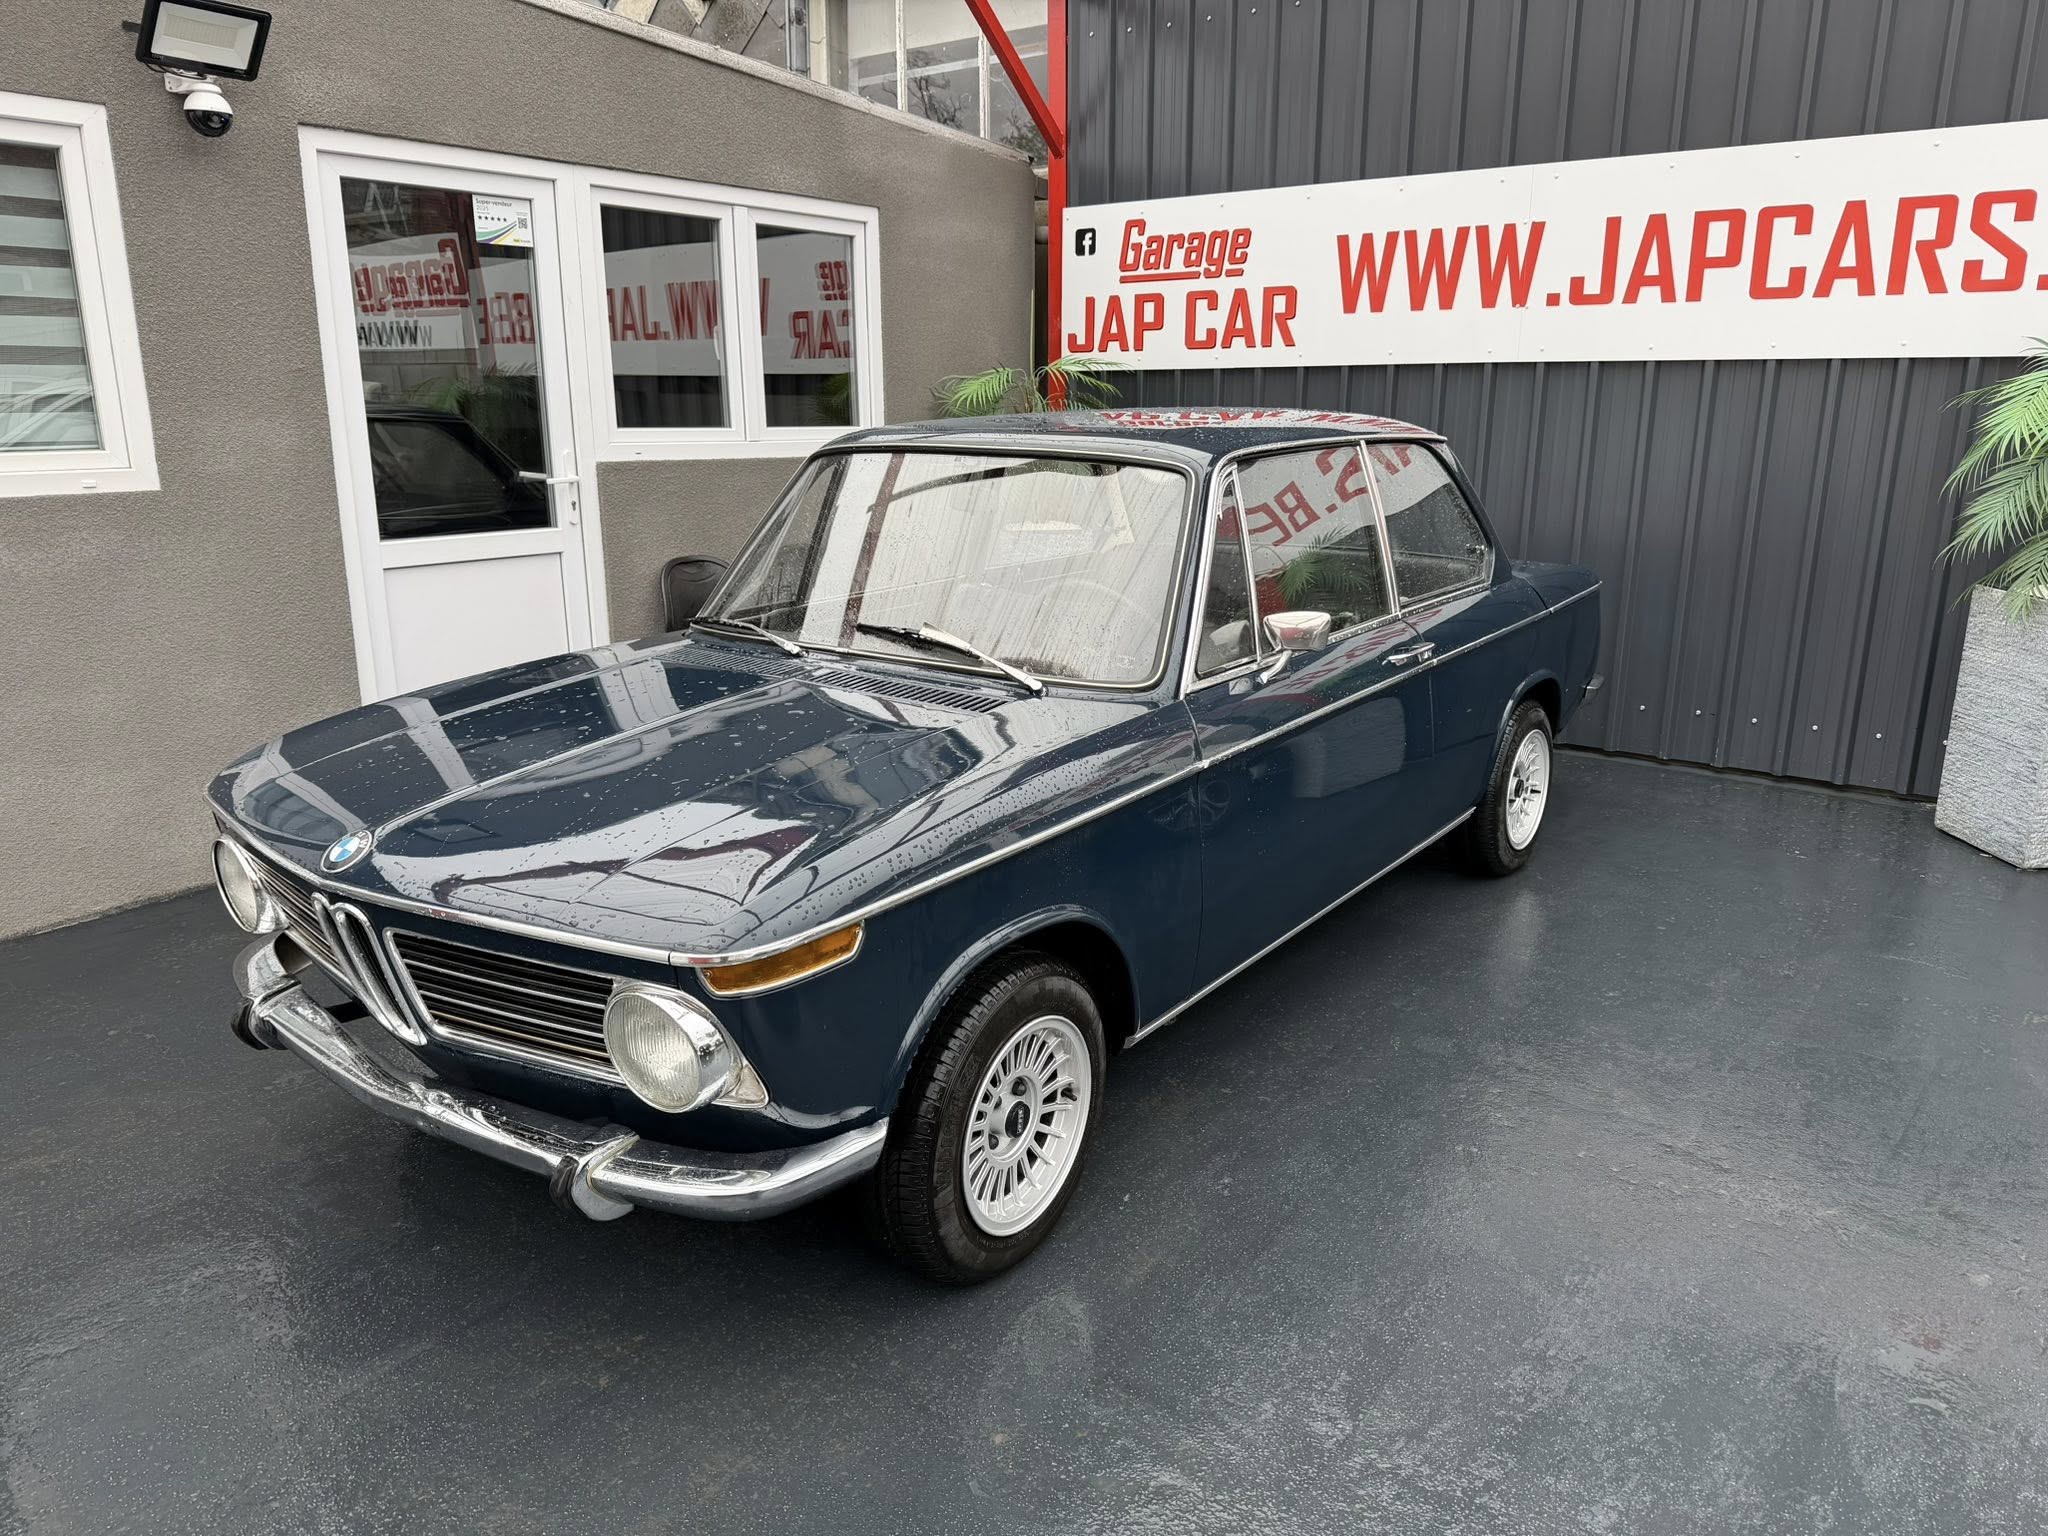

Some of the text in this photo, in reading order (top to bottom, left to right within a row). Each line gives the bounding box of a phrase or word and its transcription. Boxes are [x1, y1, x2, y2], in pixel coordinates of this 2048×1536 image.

[1120, 219, 1251, 283] Garage
[1068, 286, 1297, 352] JAP CAR
